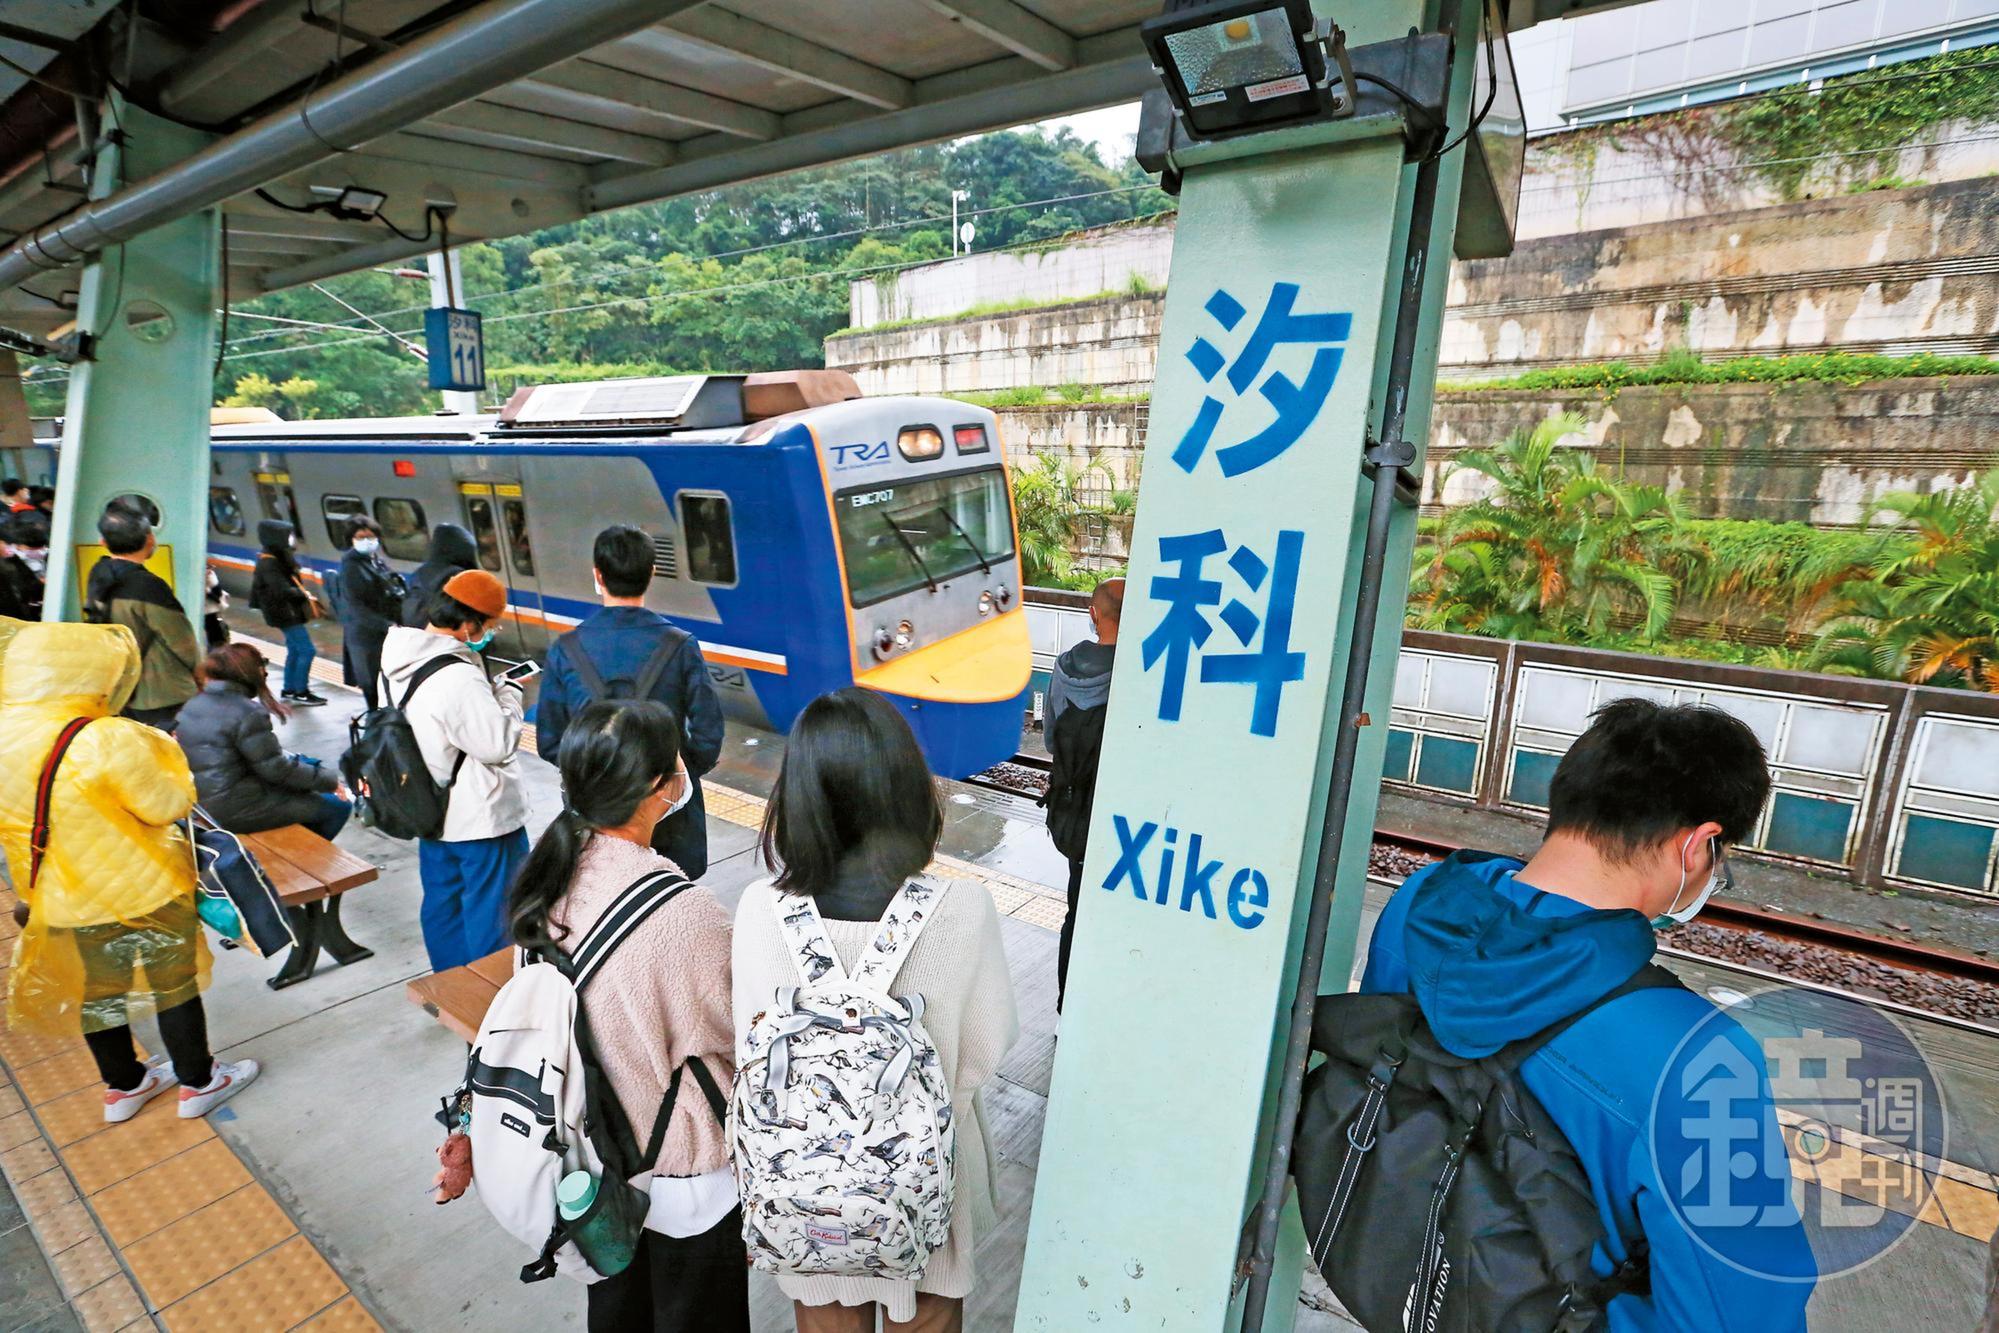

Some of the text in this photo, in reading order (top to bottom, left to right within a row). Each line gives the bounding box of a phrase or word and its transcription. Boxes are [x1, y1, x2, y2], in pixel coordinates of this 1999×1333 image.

[454, 343, 477, 385] 11
[830, 441, 890, 464] TRA
[1142, 282, 1353, 737] 汐科
[1101, 814, 1270, 930] Xike
